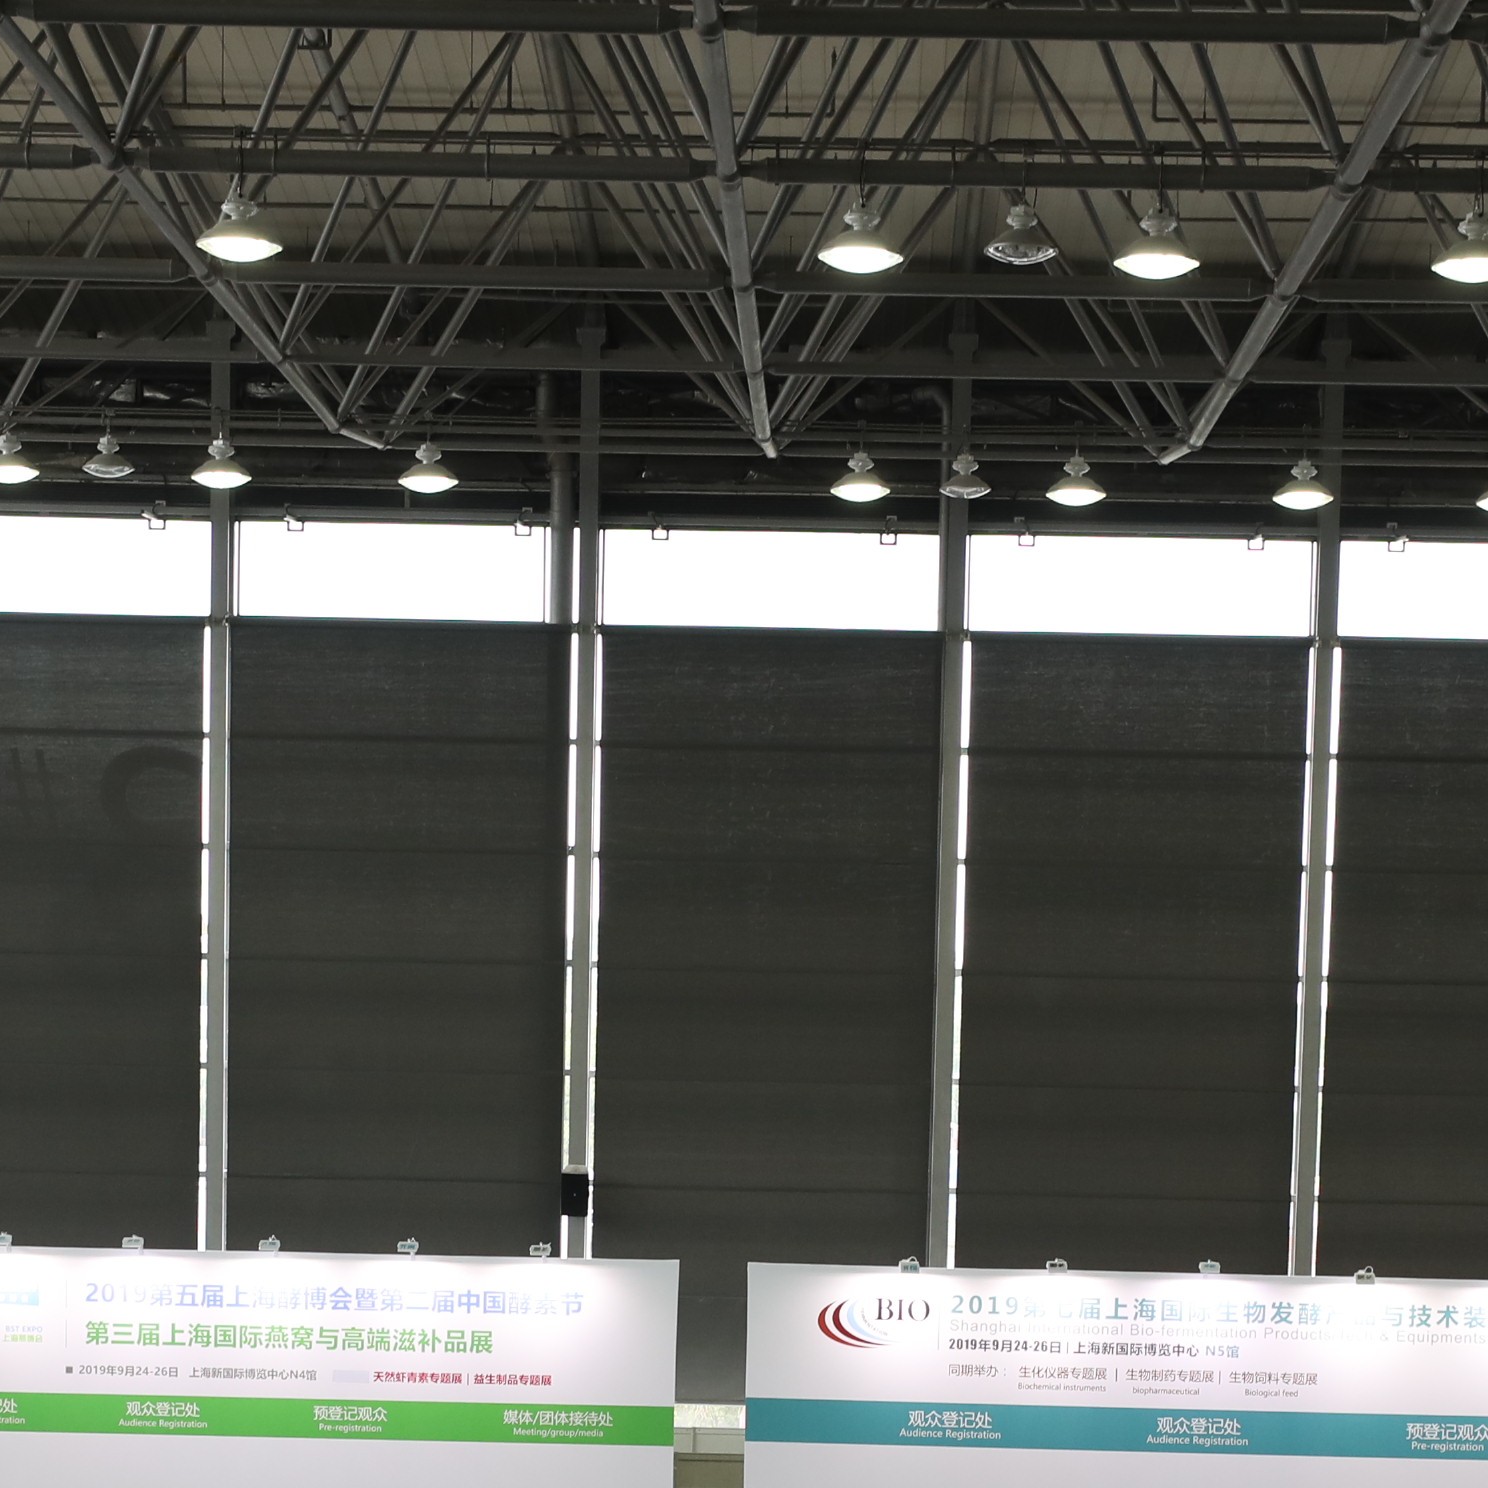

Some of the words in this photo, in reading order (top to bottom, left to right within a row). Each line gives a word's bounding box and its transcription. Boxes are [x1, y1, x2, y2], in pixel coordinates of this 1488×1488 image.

[85, 1282, 583, 1316] 2019第五届上海酵博会暨第二届中国酵素节
[875, 1298, 930, 1321] BIO
[85, 1321, 494, 1354] 第三届上海国际燕窝与高端滋补品展
[950, 1319, 1020, 1336] Shanghai
[1397, 1330, 1486, 1346] Equipments
[948, 1338, 1061, 1354] 2019年9月24-26日
[1073, 1341, 1199, 1358] 上海新国际博览中心
[1205, 1345, 1240, 1359] N5馆
[79, 1365, 179, 1378] 2019年9月24-26日
[188, 1366, 317, 1382] 上海新国际博览中心N4馆
[373, 1370, 462, 1384] 天然虾青素专题展
[473, 1373, 552, 1386] 益生制品专题展
[948, 1363, 1007, 1378] 同期举办：
[1019, 1365, 1108, 1381] 生化仪器专题展
[1125, 1368, 1214, 1384] 生物制药专题展
[1229, 1370, 1318, 1386] 生物饲料专题展
[1017, 1382, 1062, 1391] Biochemical
[1063, 1383, 1107, 1393] instruments
[1244, 1388, 1280, 1399] Biological
[1282, 1388, 1299, 1398] feed
[126, 1401, 200, 1418] 观众登记处
[313, 1405, 388, 1422] 预登记观众
[503, 1409, 613, 1427] 媒体/团体接待处
[118, 1418, 157, 1428] Audience
[159, 1419, 207, 1430] Registration
[908, 1410, 992, 1428] 观众登记处
[1156, 1416, 1241, 1436] 观众登记处
[318, 1422, 382, 1434] Pre-registration
[513, 1427, 604, 1439] Meeting/group/media
[899, 1427, 943, 1438] Audience
[945, 1429, 1001, 1441] Registration
[1146, 1434, 1191, 1444] Audience
[1193, 1435, 1249, 1447] Registration
[1411, 1441, 1485, 1453] Pre-registration
